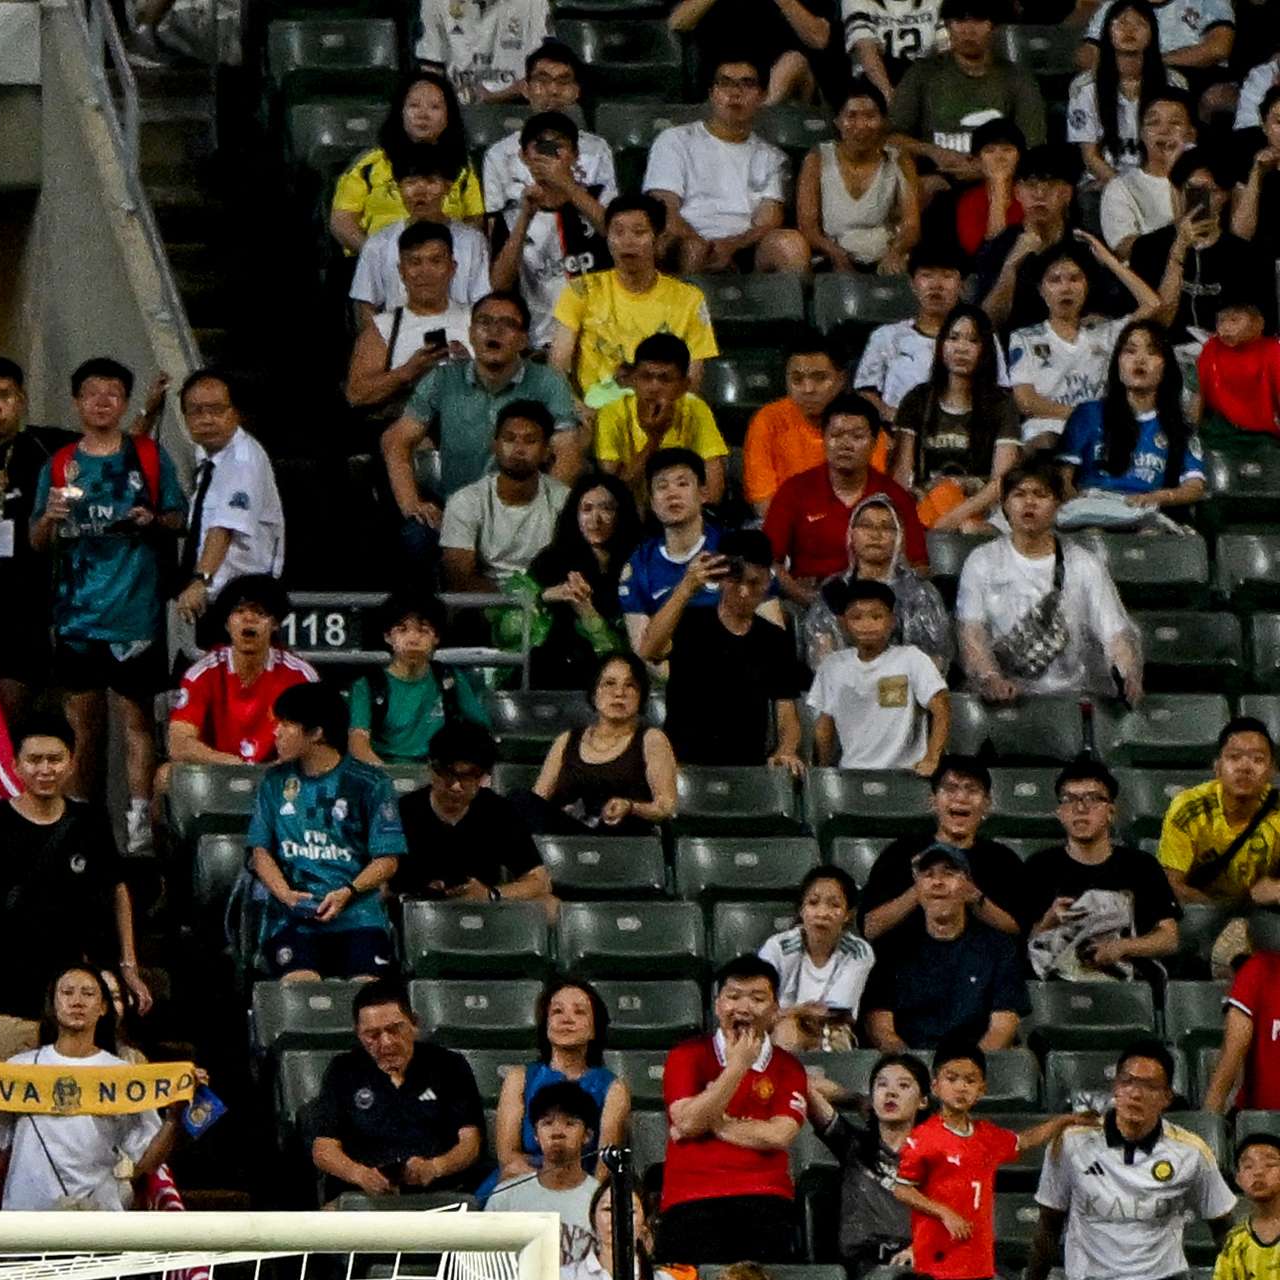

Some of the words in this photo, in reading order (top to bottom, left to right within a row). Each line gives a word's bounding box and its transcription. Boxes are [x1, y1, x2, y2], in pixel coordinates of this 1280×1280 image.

[280, 612, 346, 647] 118
[304, 830, 328, 846] Fly
[98, 1073, 193, 1104] NORD
[971, 1181, 982, 1210] 7
